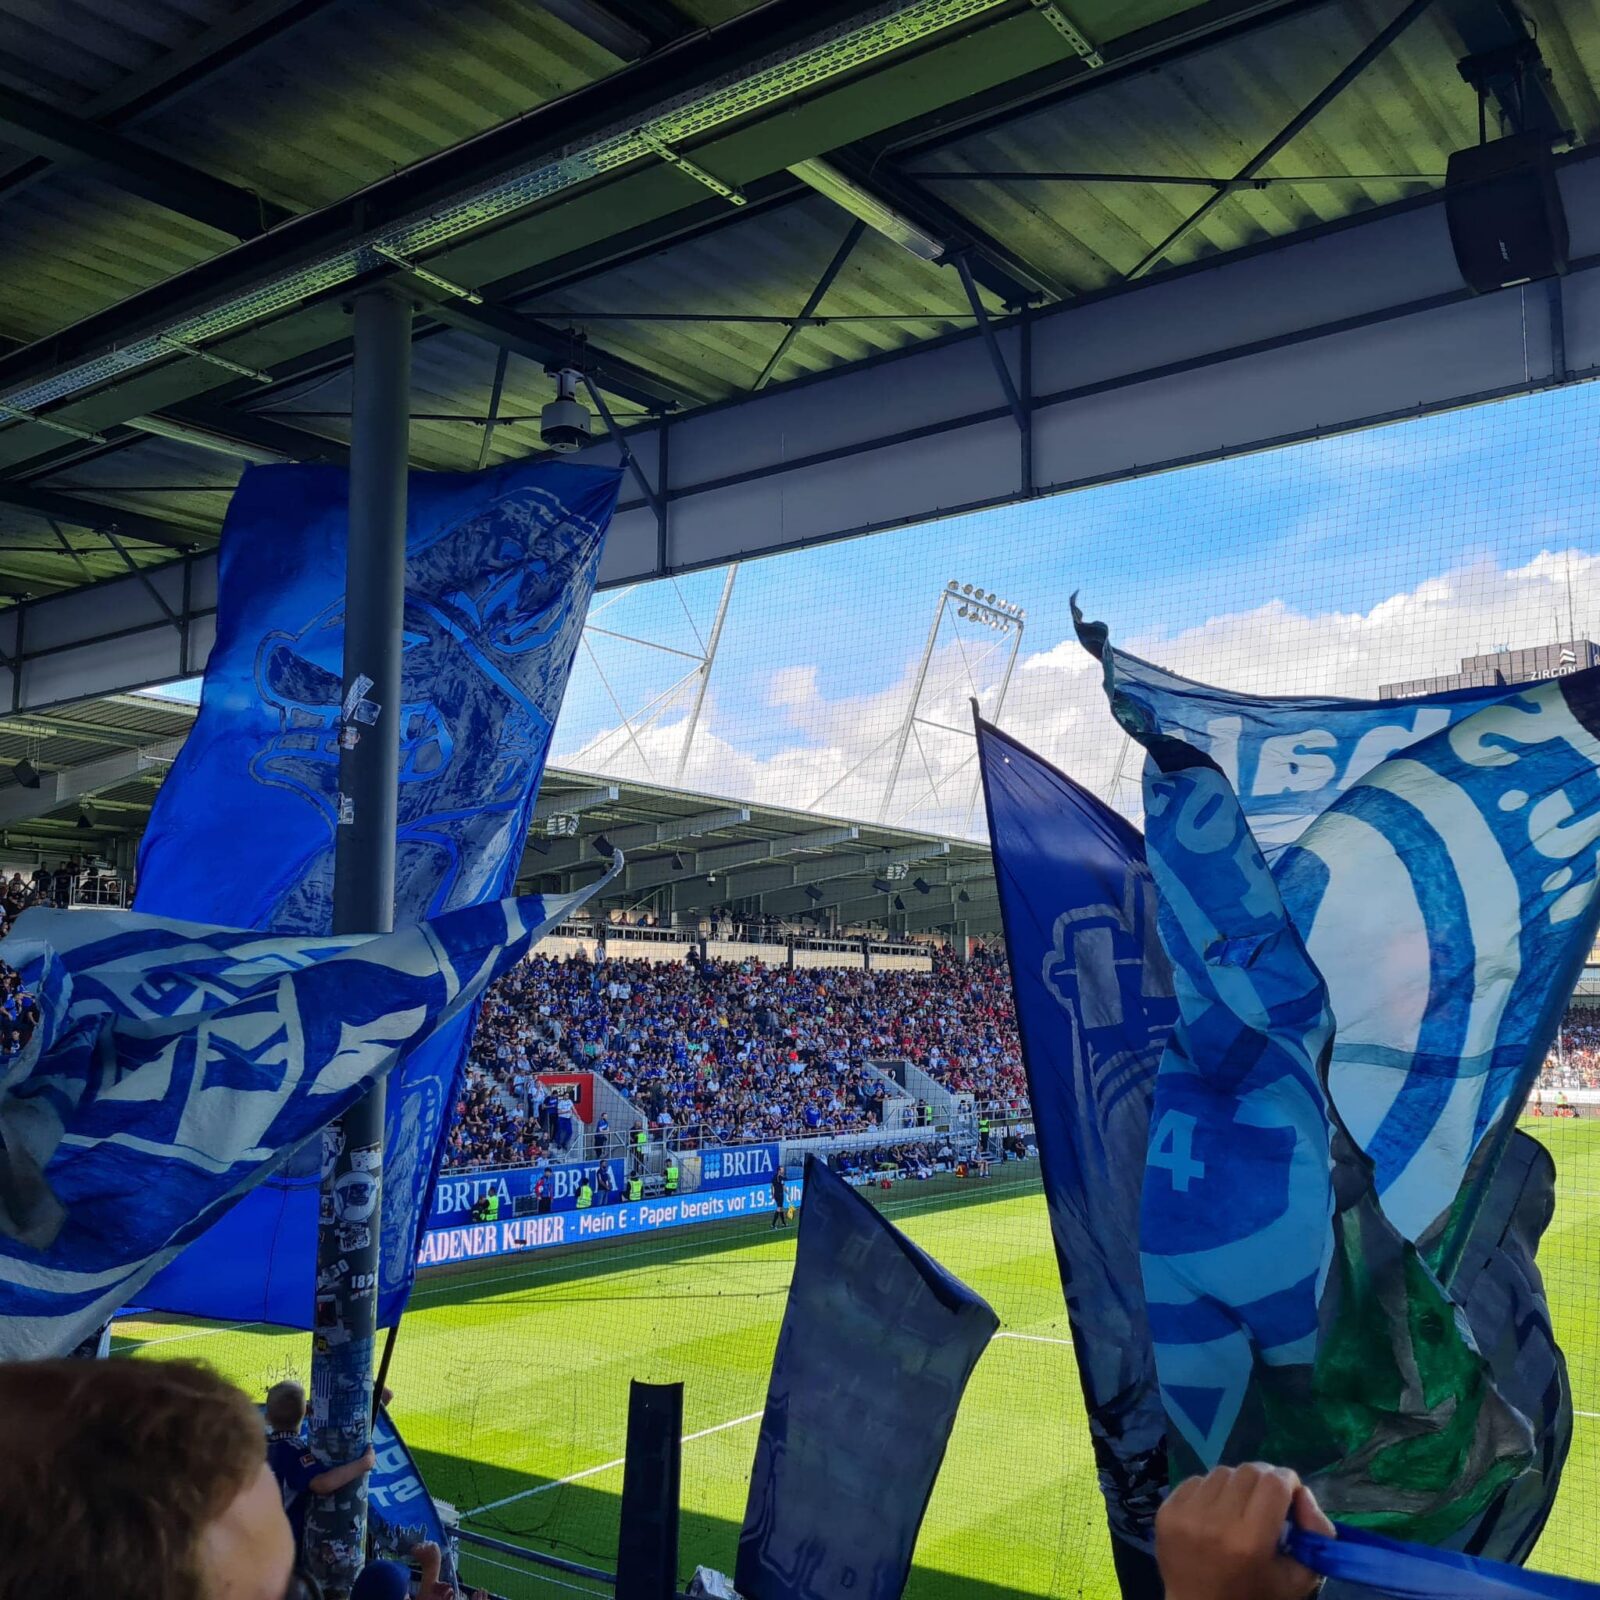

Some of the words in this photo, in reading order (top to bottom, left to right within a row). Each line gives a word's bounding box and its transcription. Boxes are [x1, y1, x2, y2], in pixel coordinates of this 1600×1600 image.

[1530, 665, 1577, 681] ZIRCON
[722, 1148, 774, 1178] BRITA
[437, 1177, 512, 1215] BRITA
[503, 1215, 565, 1251] KURIER
[579, 1211, 615, 1235] Mein
[618, 1209, 627, 1229] E
[640, 1205, 678, 1227] Paper
[681, 1194, 725, 1219] bereits
[728, 1197, 746, 1215] vor
[749, 1189, 776, 1208] 19.3
[786, 1184, 802, 1203] Uh
